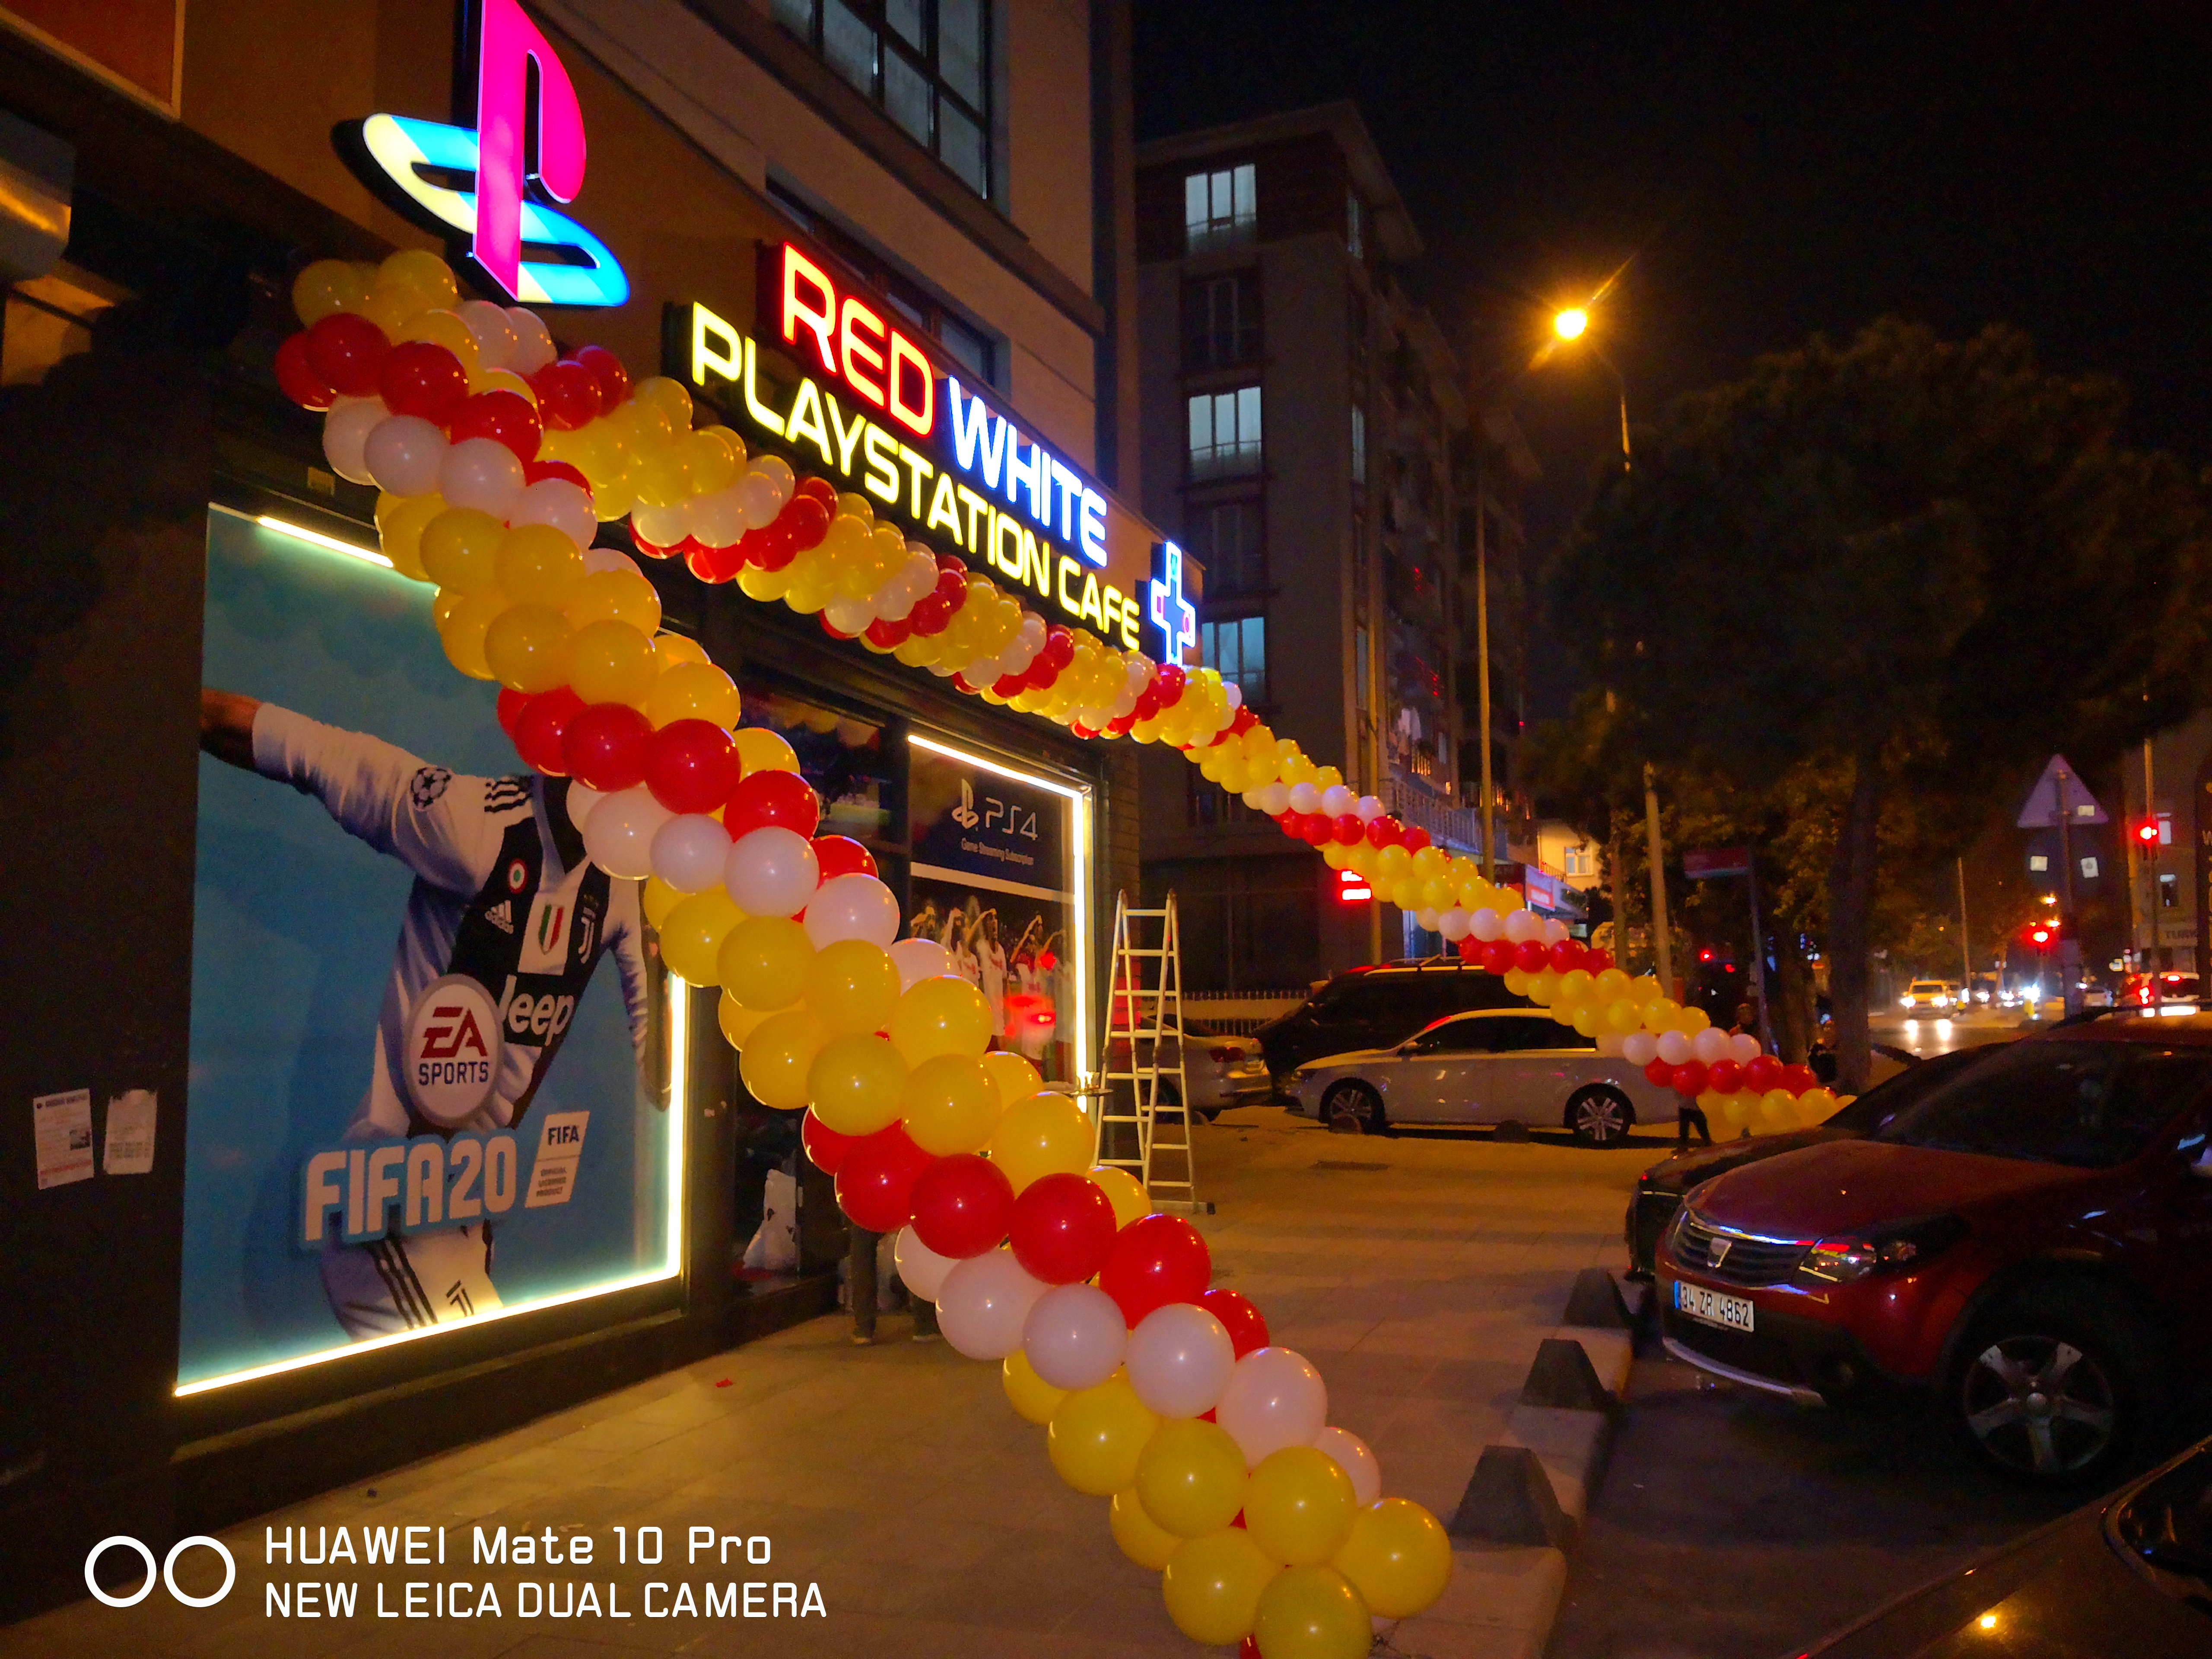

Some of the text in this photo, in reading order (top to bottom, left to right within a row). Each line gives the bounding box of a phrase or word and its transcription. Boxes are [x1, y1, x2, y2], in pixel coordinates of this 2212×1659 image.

[782, 241, 1109, 568] RED WHITE
[692, 301, 1141, 652] PLAYSTATION CAFE
[985, 797, 1038, 841] PS4
[421, 1007, 488, 1058] EA
[418, 1061, 489, 1086] SPORTS
[547, 1125, 579, 1146] FIFA
[1682, 1286, 1696, 1311] 34
